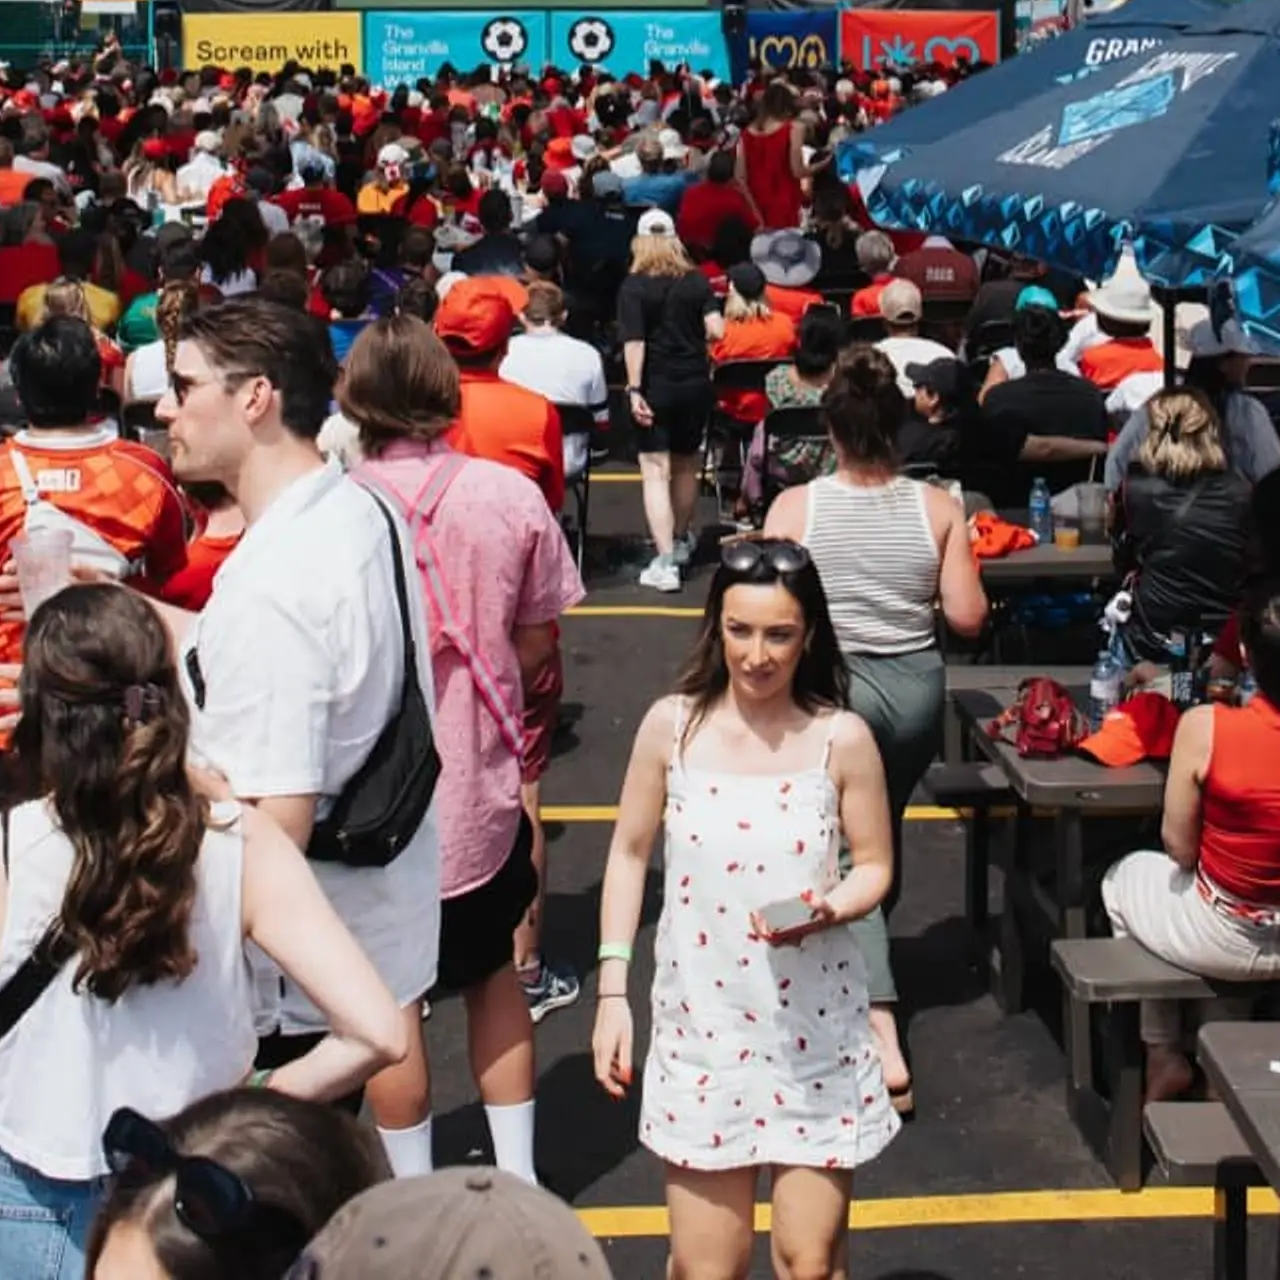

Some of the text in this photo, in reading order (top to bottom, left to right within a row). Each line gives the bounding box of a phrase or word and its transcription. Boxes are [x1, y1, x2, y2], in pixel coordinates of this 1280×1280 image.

[384, 24, 414, 39] The
[645, 24, 674, 39] The
[196, 39, 348, 62] Scream with
